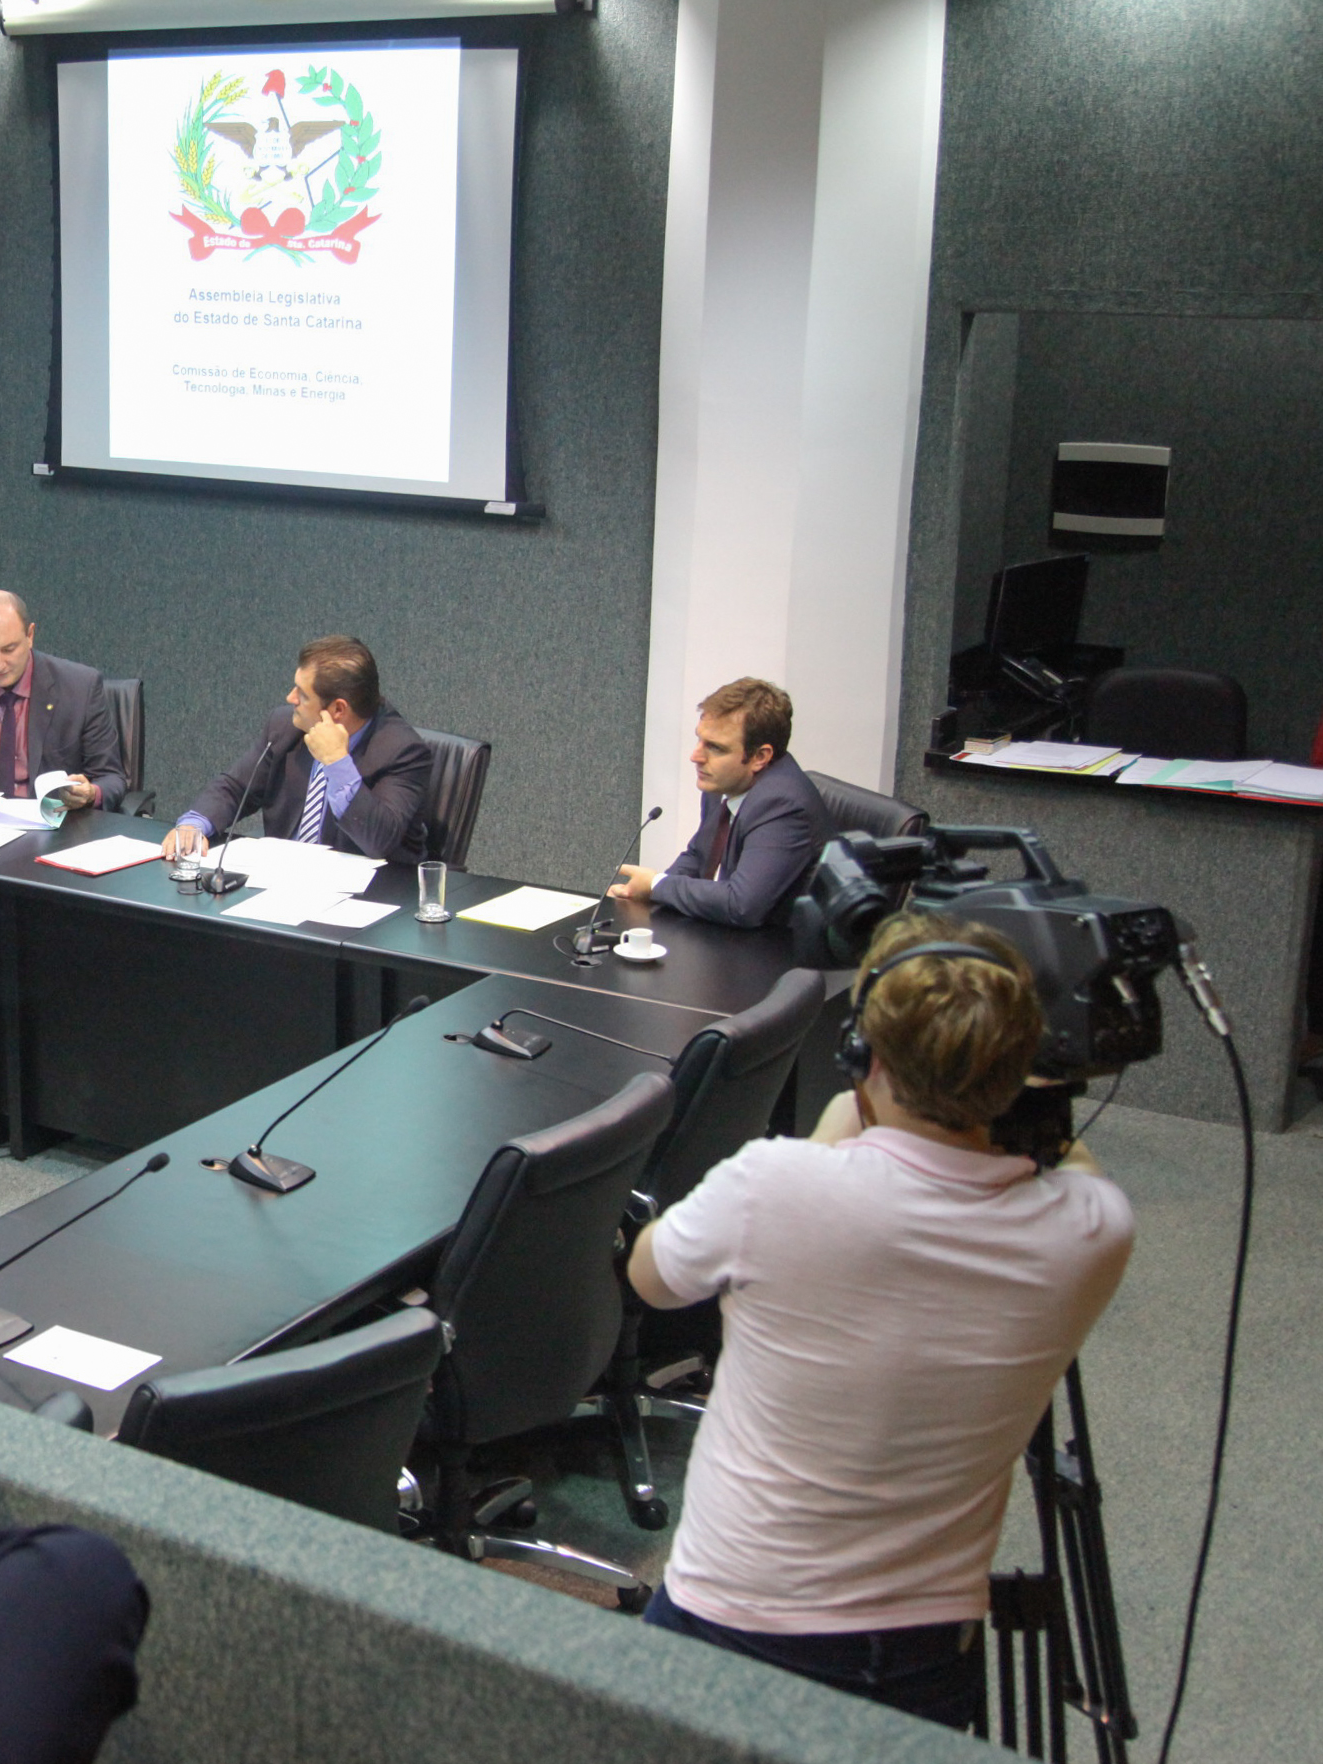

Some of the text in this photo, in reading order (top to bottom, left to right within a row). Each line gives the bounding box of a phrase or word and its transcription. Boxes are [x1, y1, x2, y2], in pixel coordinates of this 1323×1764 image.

[203, 236, 237, 248] Estado
[308, 239, 352, 251] Catarina
[188, 288, 341, 307] Assembleia Legislativa
[173, 310, 363, 330] do Estado de Santa Catarina
[172, 363, 228, 378] Comissão
[232, 366, 246, 379] de
[252, 384, 286, 398] Minas
[289, 388, 296, 398] e
[300, 386, 346, 403] Energia
